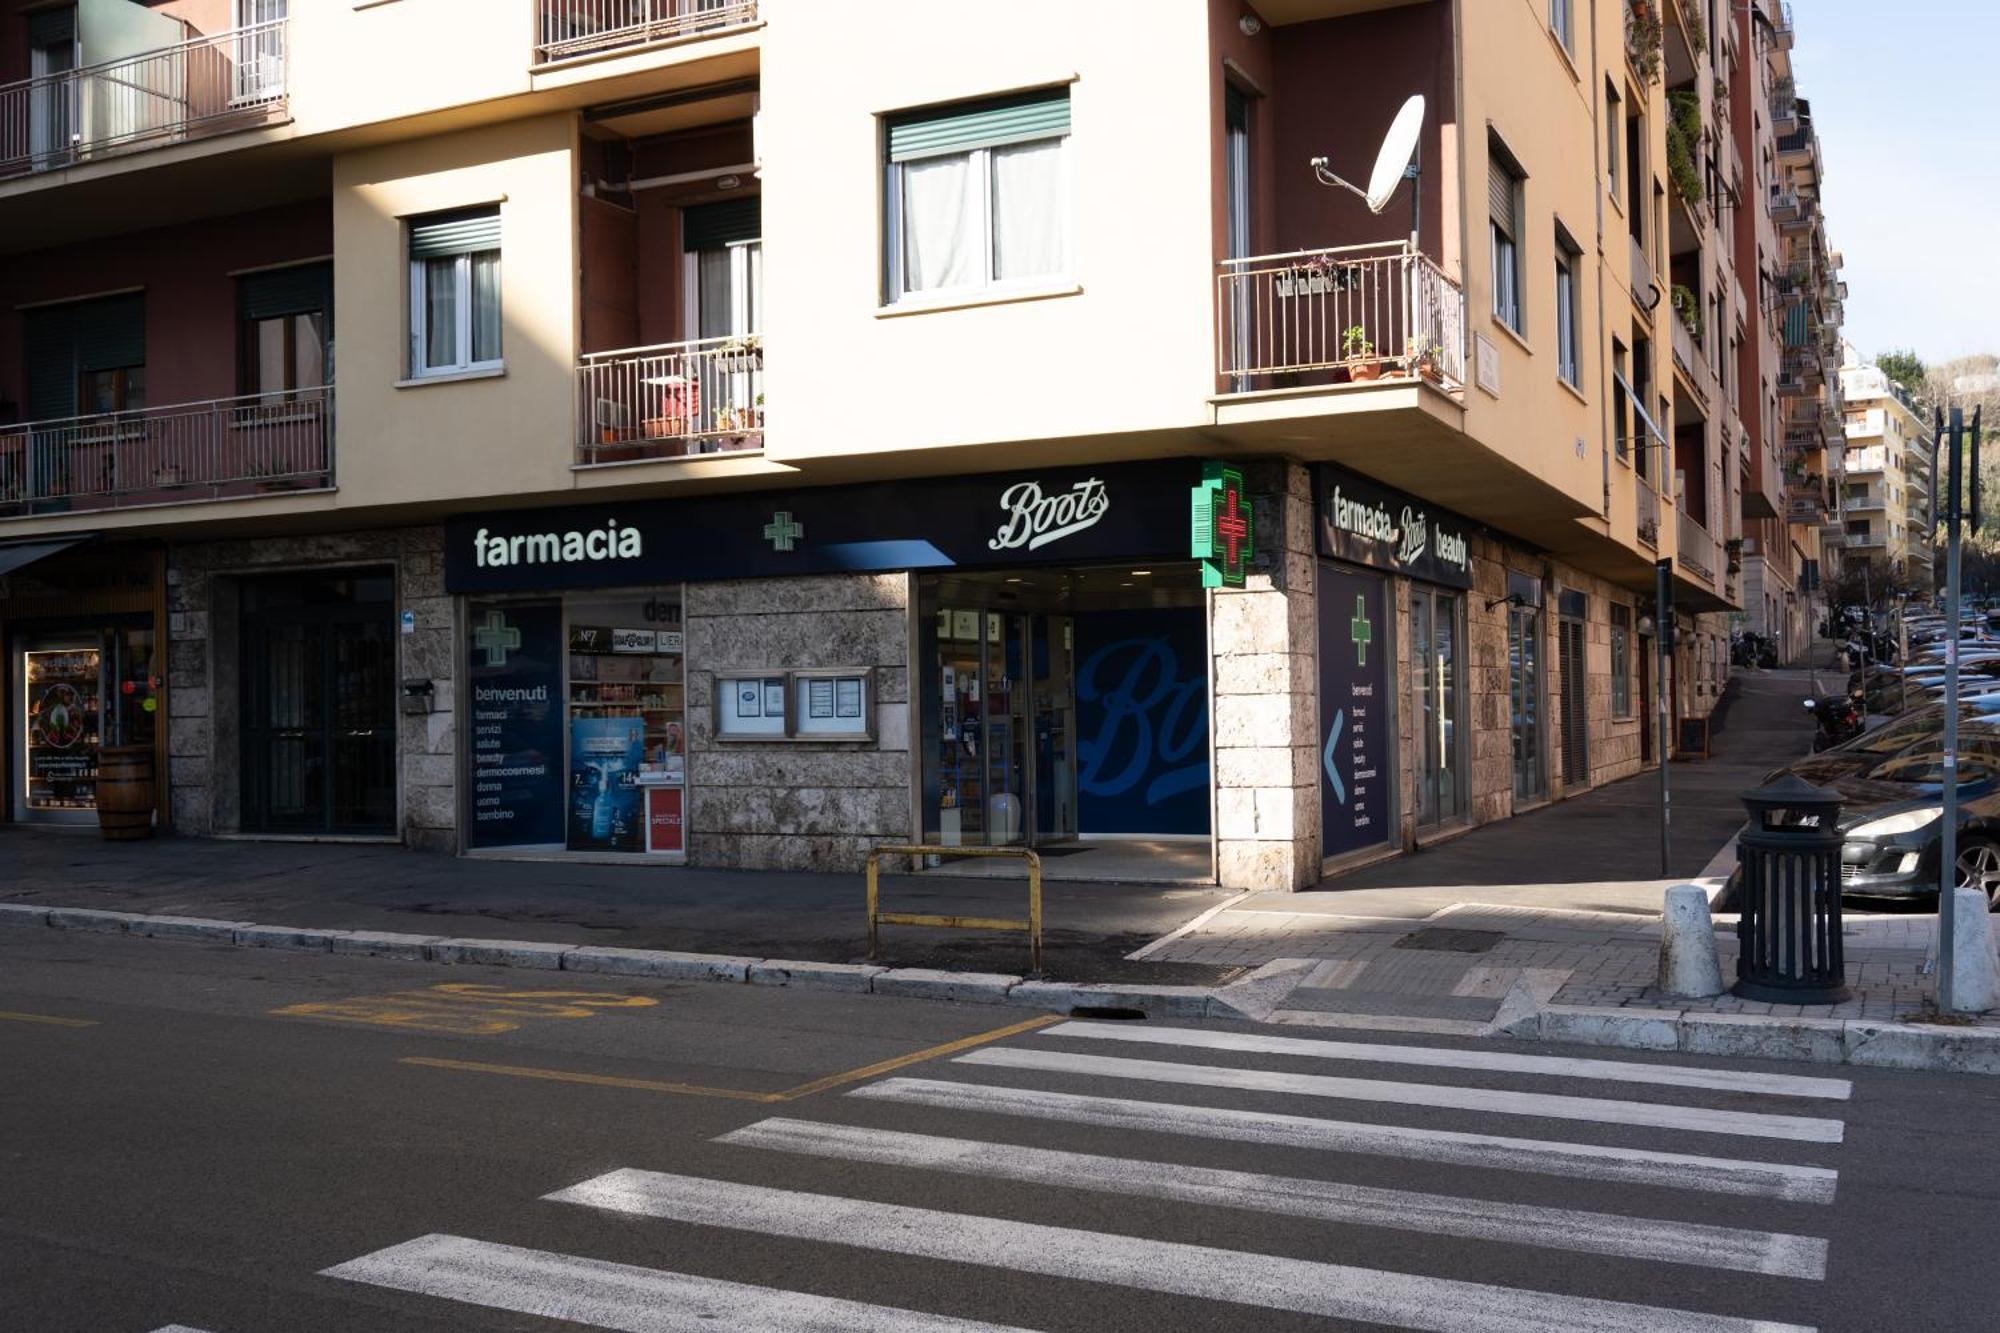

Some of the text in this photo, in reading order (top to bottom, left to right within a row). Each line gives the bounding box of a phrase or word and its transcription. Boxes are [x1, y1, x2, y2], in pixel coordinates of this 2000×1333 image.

[988, 477, 1109, 551] Boots
[1333, 485, 1466, 573] farmacia Boots beauty
[474, 518, 642, 567] farmacia
[475, 685, 547, 702] benvenuti
[476, 709, 508, 721] farmaci
[476, 765, 545, 778] dermocosmesi
[477, 782, 502, 793] donna
[477, 797, 500, 807] uomo
[477, 808, 515, 821] bambino
